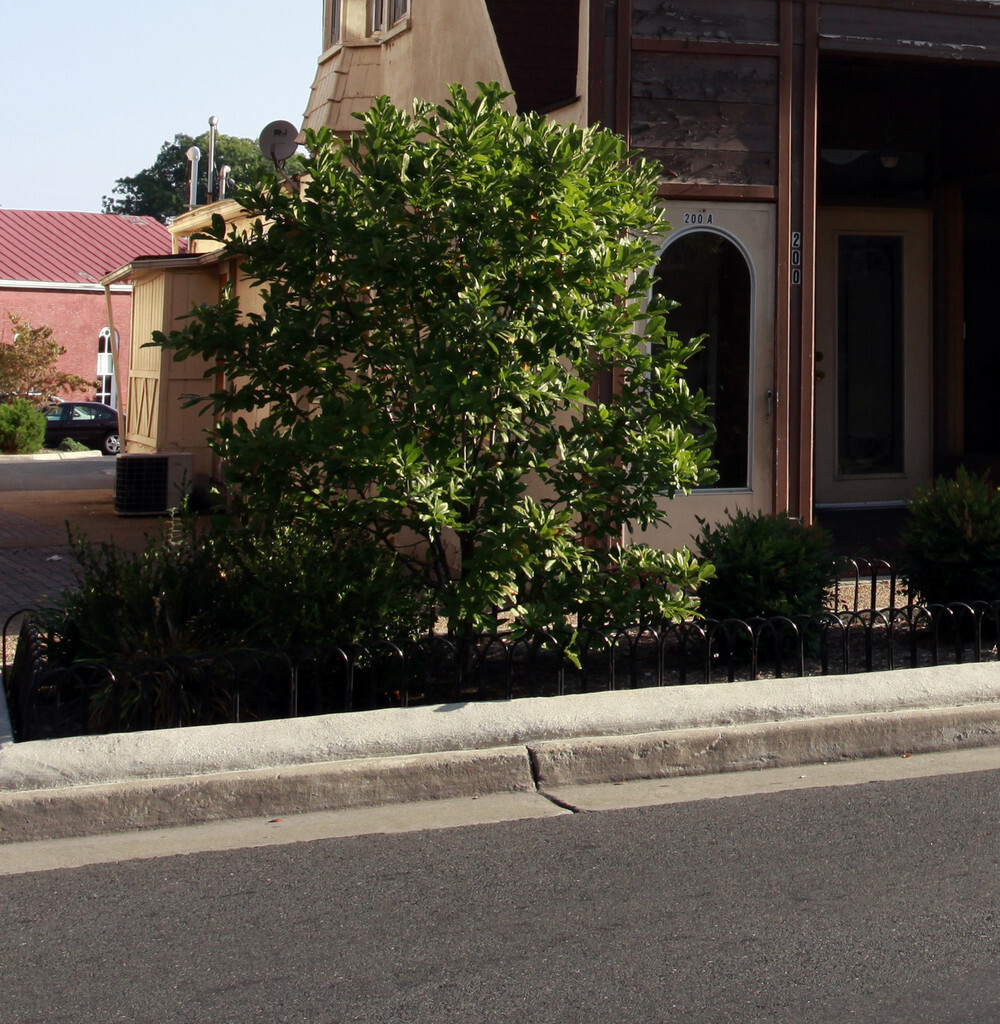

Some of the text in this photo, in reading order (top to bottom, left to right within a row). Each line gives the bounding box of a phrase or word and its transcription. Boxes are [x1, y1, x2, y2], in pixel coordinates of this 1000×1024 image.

[685, 213, 713, 224] 200 A
[792, 232, 800, 285] 200
